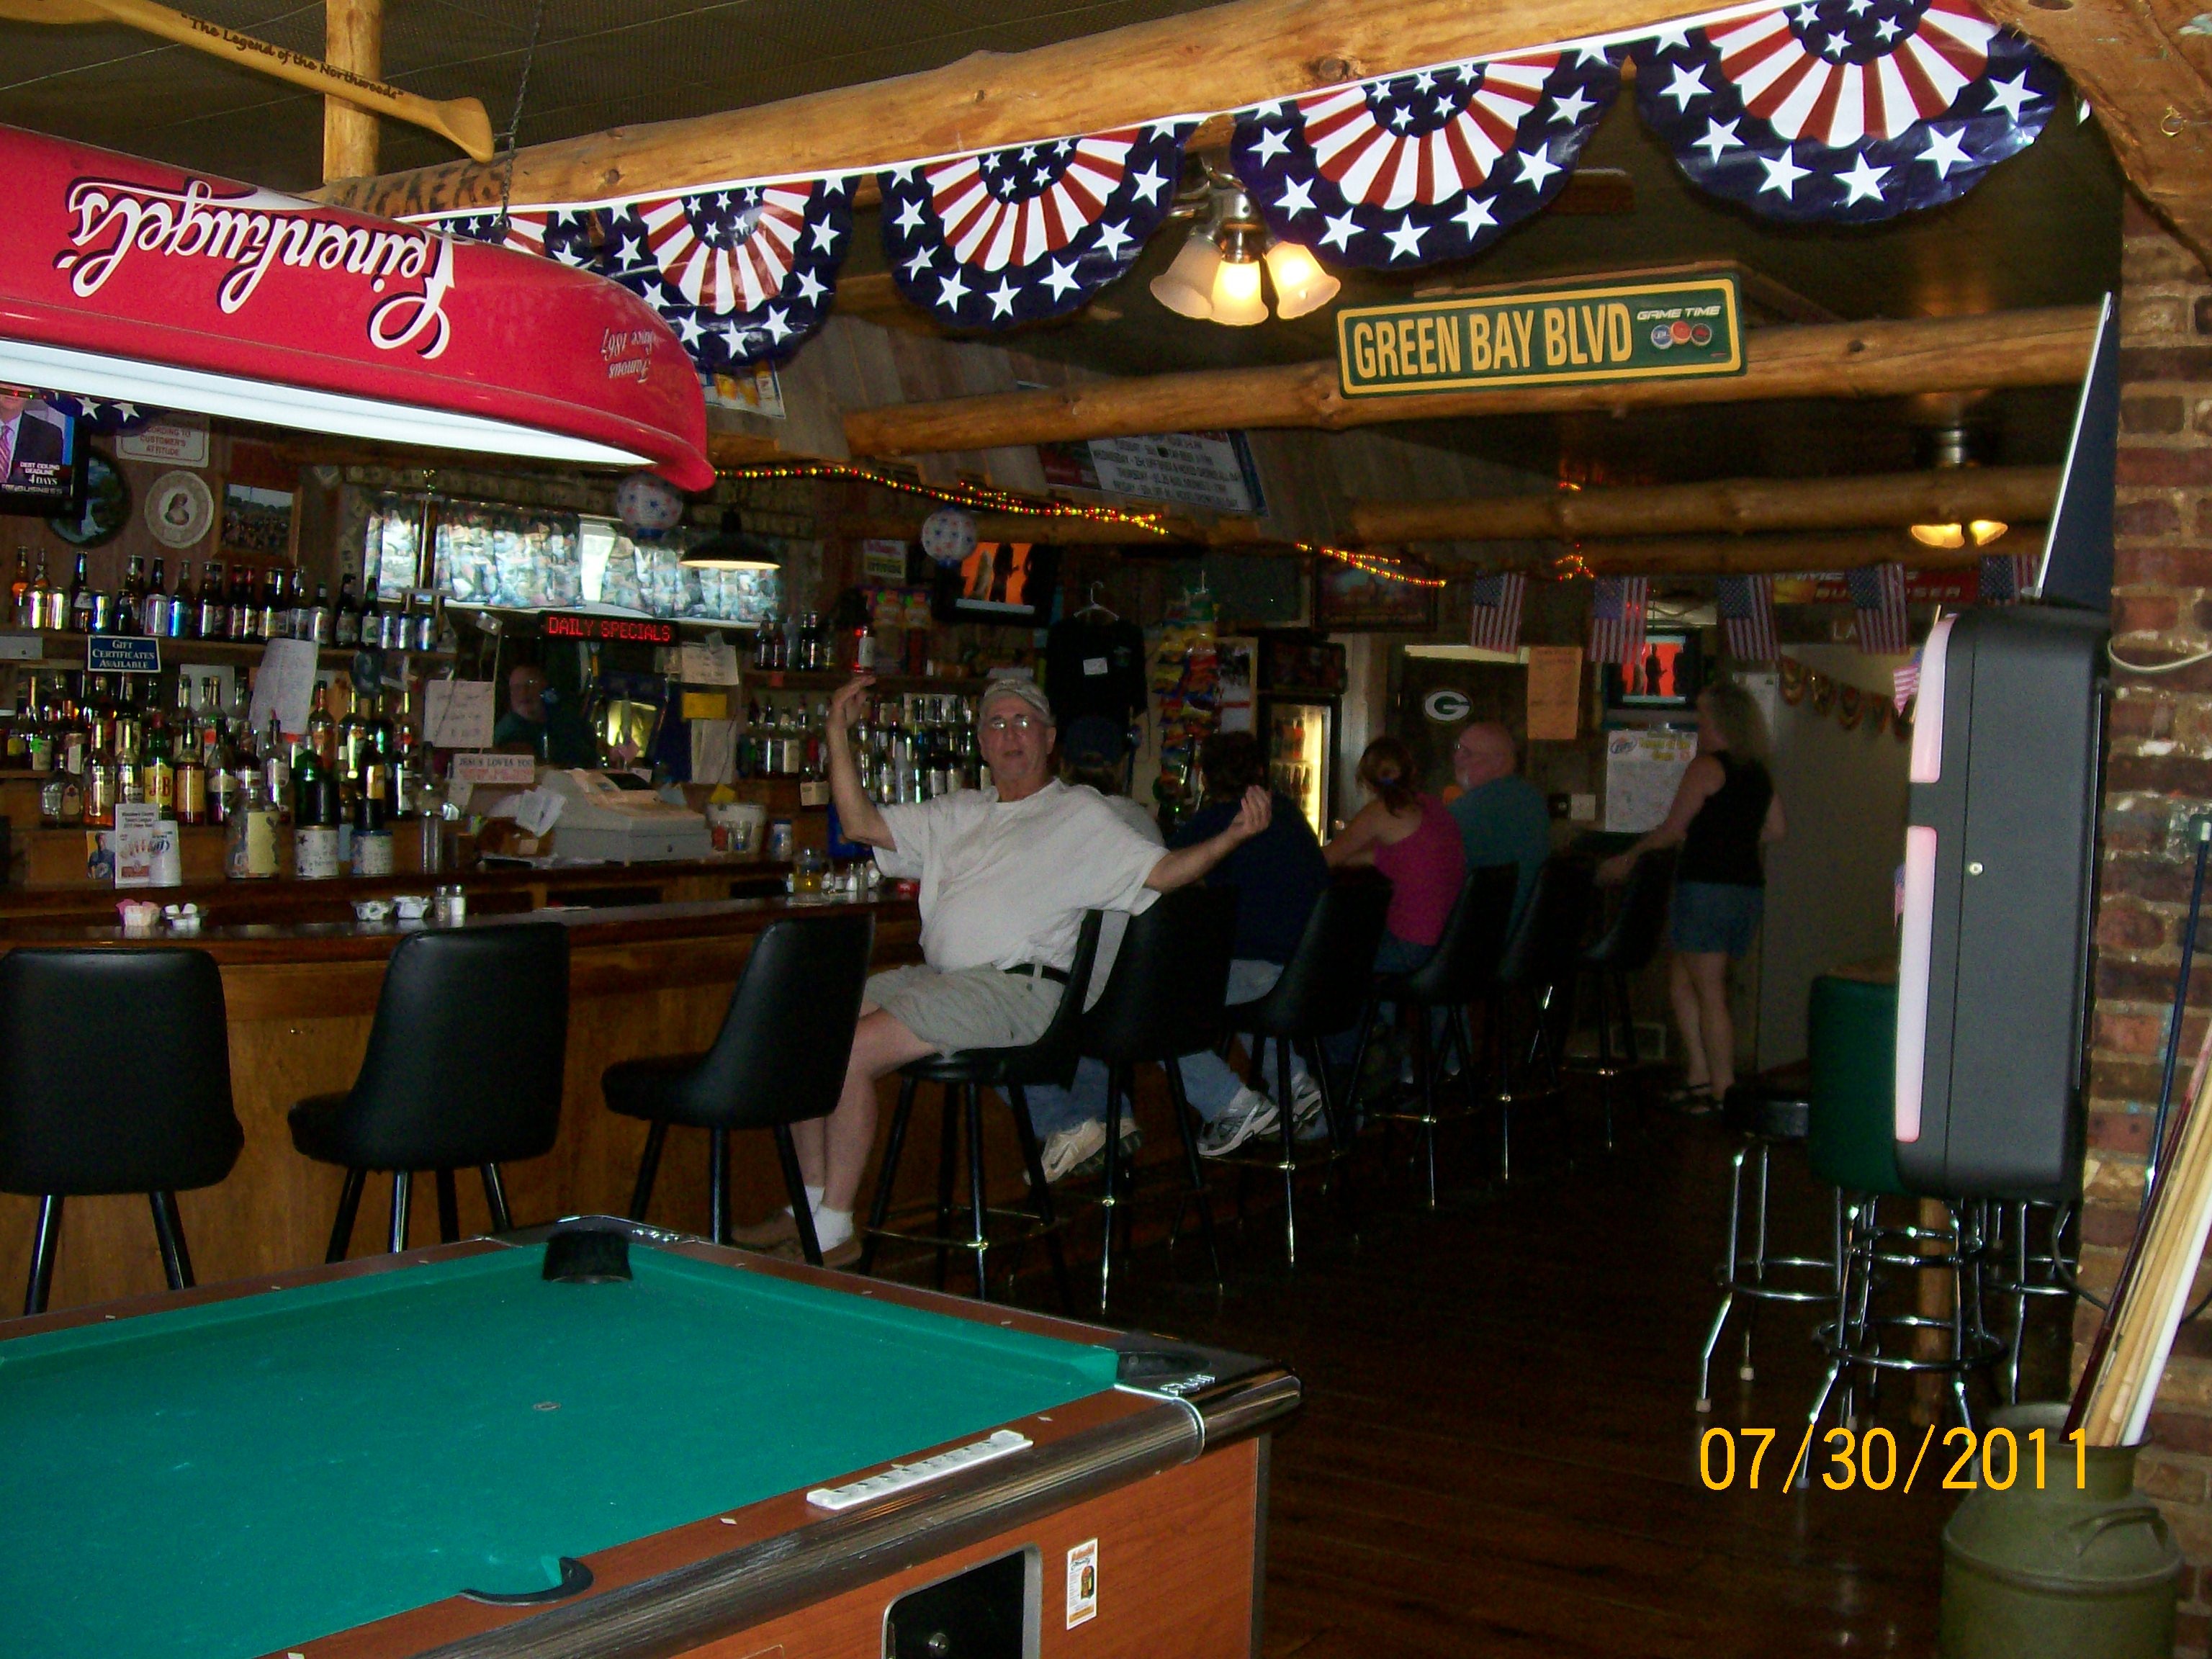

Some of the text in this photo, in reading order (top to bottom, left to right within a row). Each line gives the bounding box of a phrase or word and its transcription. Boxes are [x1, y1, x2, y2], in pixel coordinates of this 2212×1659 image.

[222, 30, 274, 57] Legend
[277, 50, 292, 65] of
[293, 53, 317, 71] the
[1637, 305, 1722, 320] GAME TIME
[600, 328, 627, 361] 1867
[1354, 302, 1633, 379] GREEN BAY BLVD
[608, 358, 651, 383] Famous
[36, 477, 58, 485] DAYS
[549, 616, 671, 642] DAILY SPECIALS
[112, 639, 133, 649] GIFT
[92, 648, 155, 660] CERTIFICATES
[99, 659, 148, 669] AVAILABLE
[459, 757, 483, 766] JESUS
[487, 757, 513, 767] LOVES
